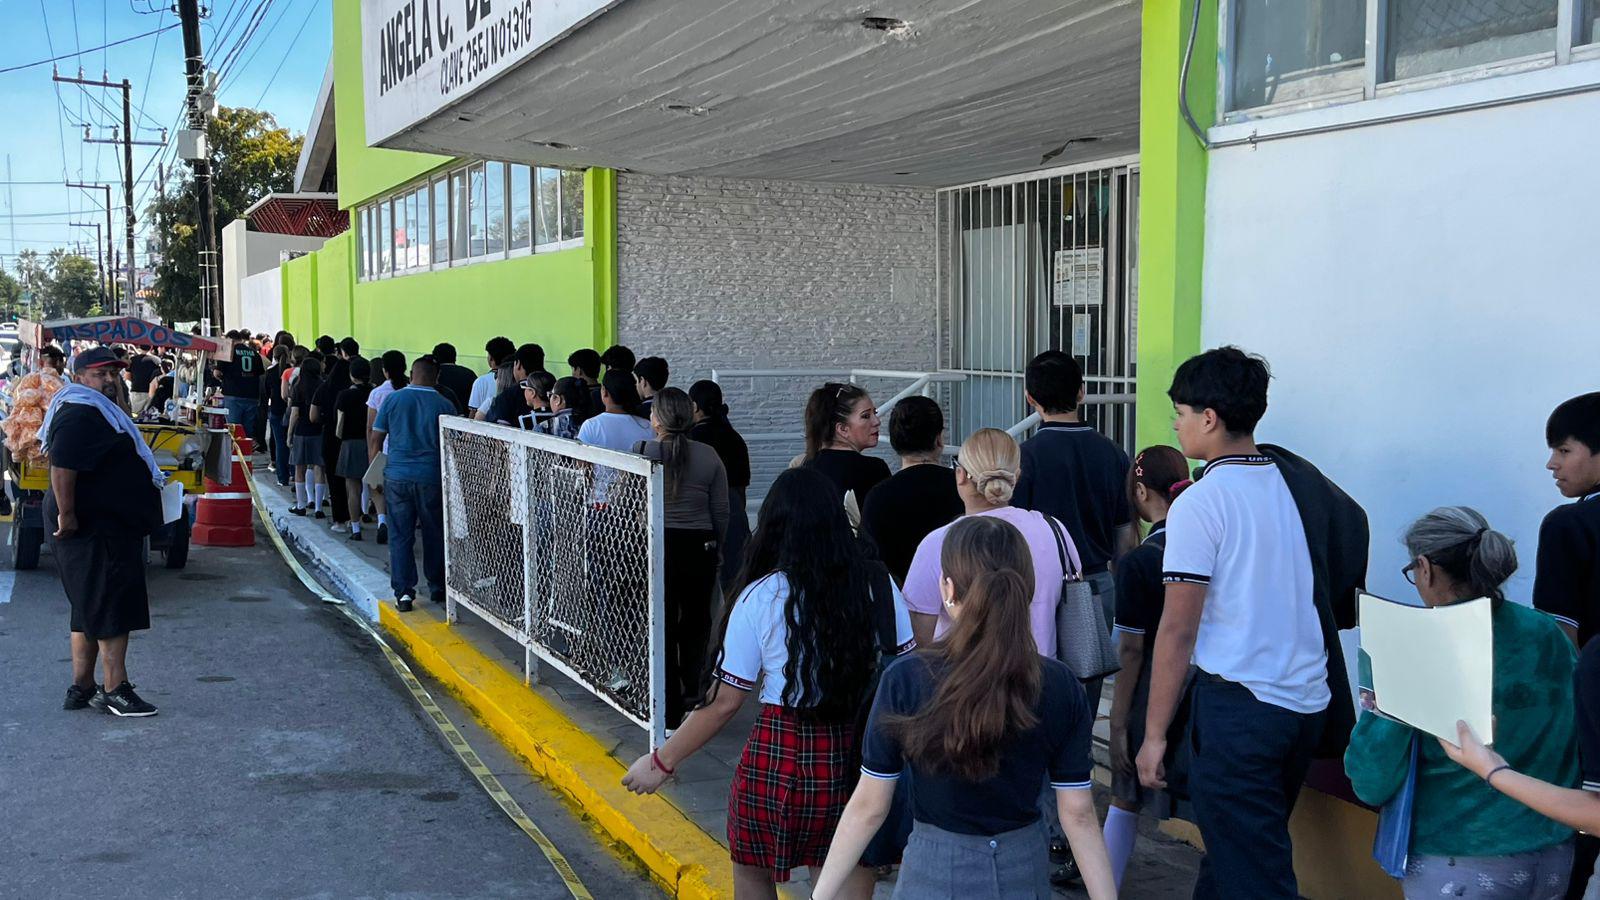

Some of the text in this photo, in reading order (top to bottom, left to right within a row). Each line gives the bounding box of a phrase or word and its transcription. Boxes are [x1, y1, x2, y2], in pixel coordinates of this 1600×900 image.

[380, 0, 433, 97] ANGELA
[437, 0, 454, 52] C.
[441, 46, 464, 95] CLAVE
